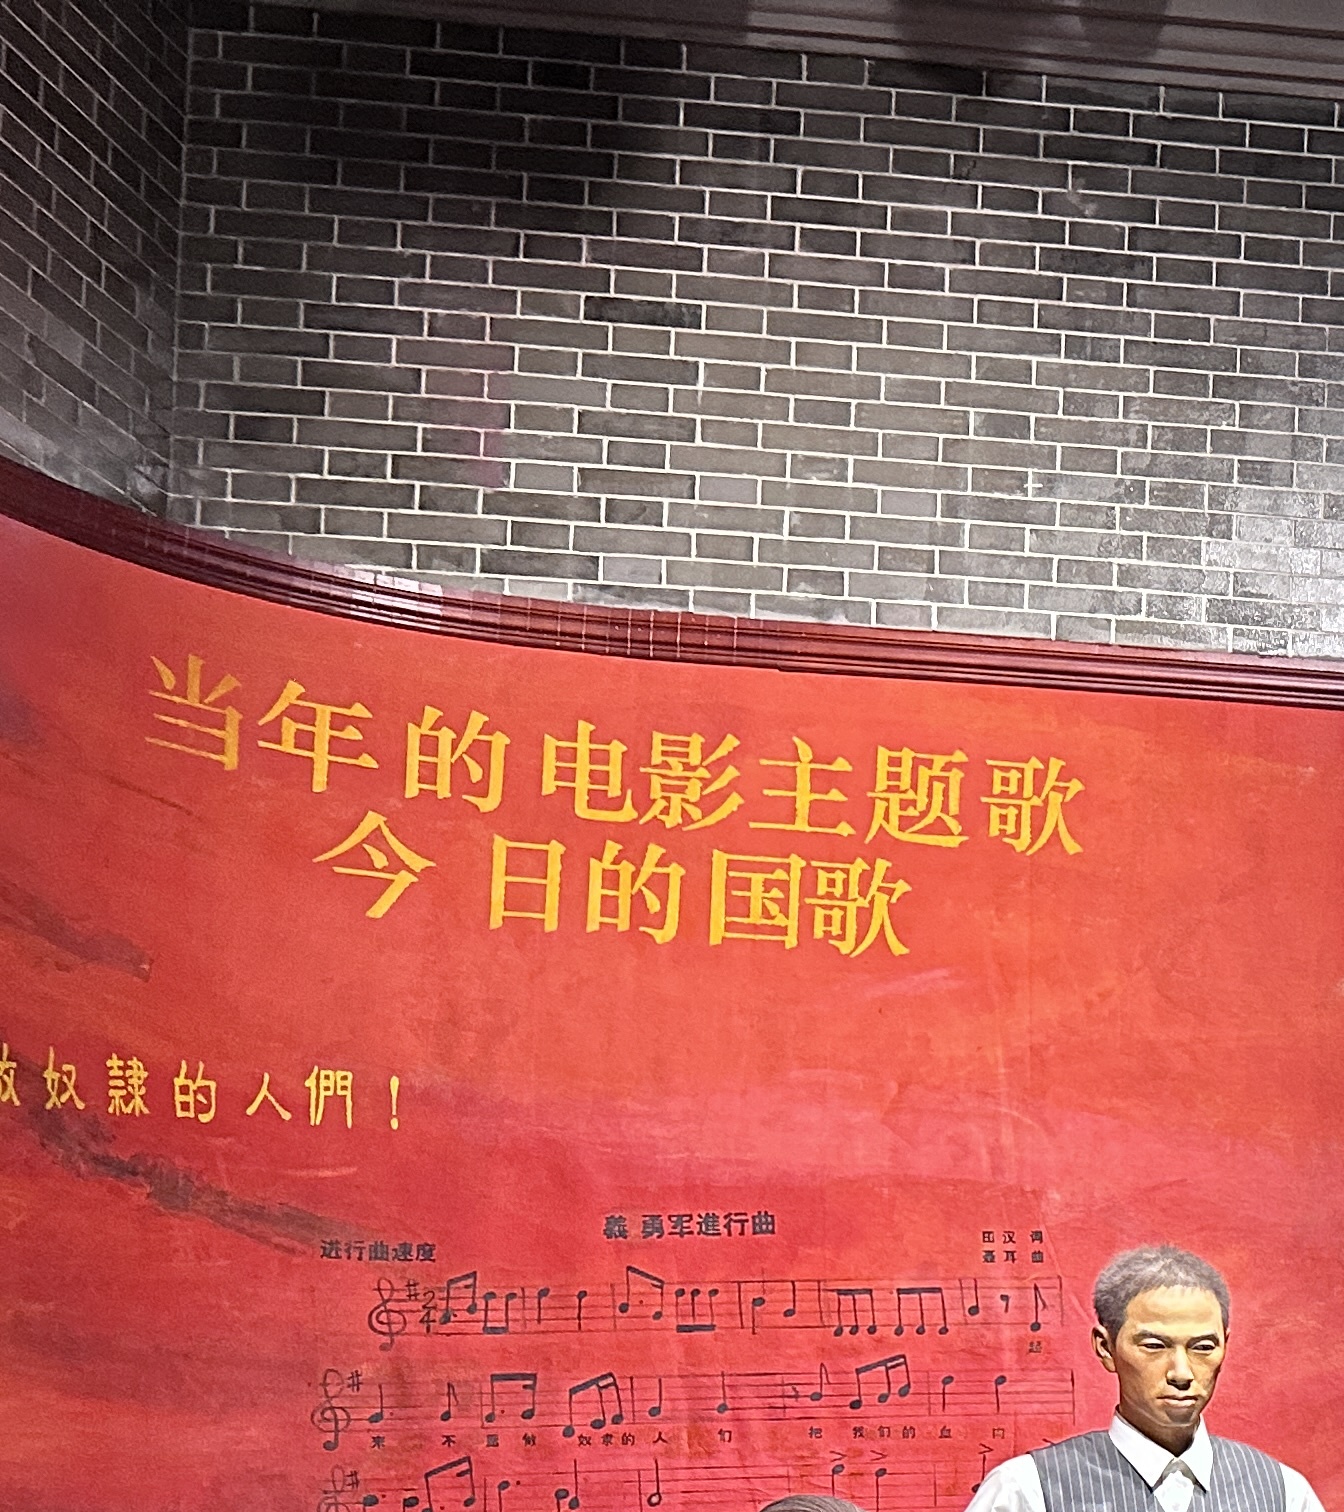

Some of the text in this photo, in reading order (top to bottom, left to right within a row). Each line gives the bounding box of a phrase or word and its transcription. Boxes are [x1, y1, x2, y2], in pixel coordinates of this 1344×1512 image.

[143, 655, 1086, 857] 当年的电影主题歌
[314, 811, 913, 959] 今日的国歌
